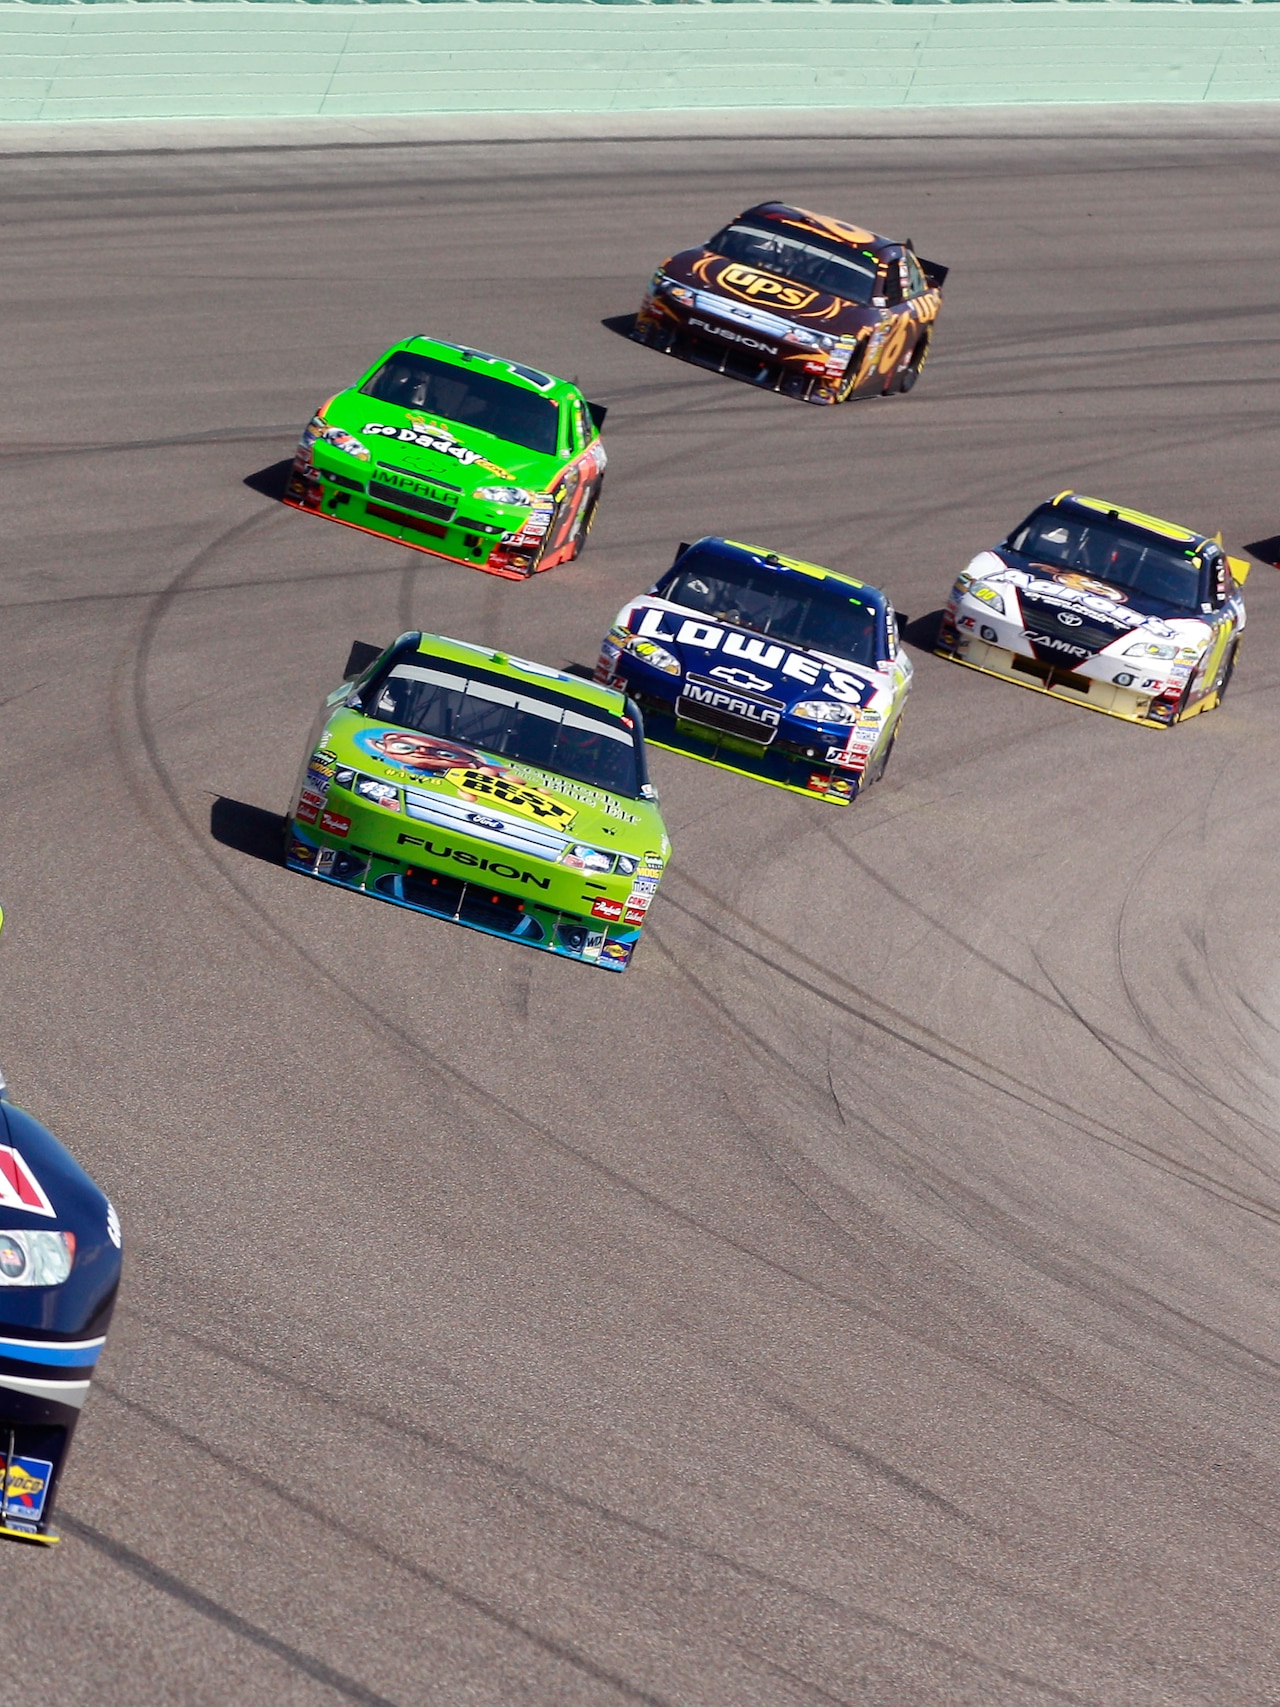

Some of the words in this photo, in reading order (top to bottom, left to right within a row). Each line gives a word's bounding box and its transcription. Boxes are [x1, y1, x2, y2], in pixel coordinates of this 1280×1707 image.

[688, 318, 778, 355] FUSION
[372, 469, 460, 505] IMPALA
[637, 608, 866, 706] LOWE'S
[1020, 630, 1099, 660] CAMRY
[682, 683, 781, 726] IMPALA
[462, 779, 559, 817] BUY
[463, 770, 573, 817] BEST
[396, 832, 551, 891] FUSION
